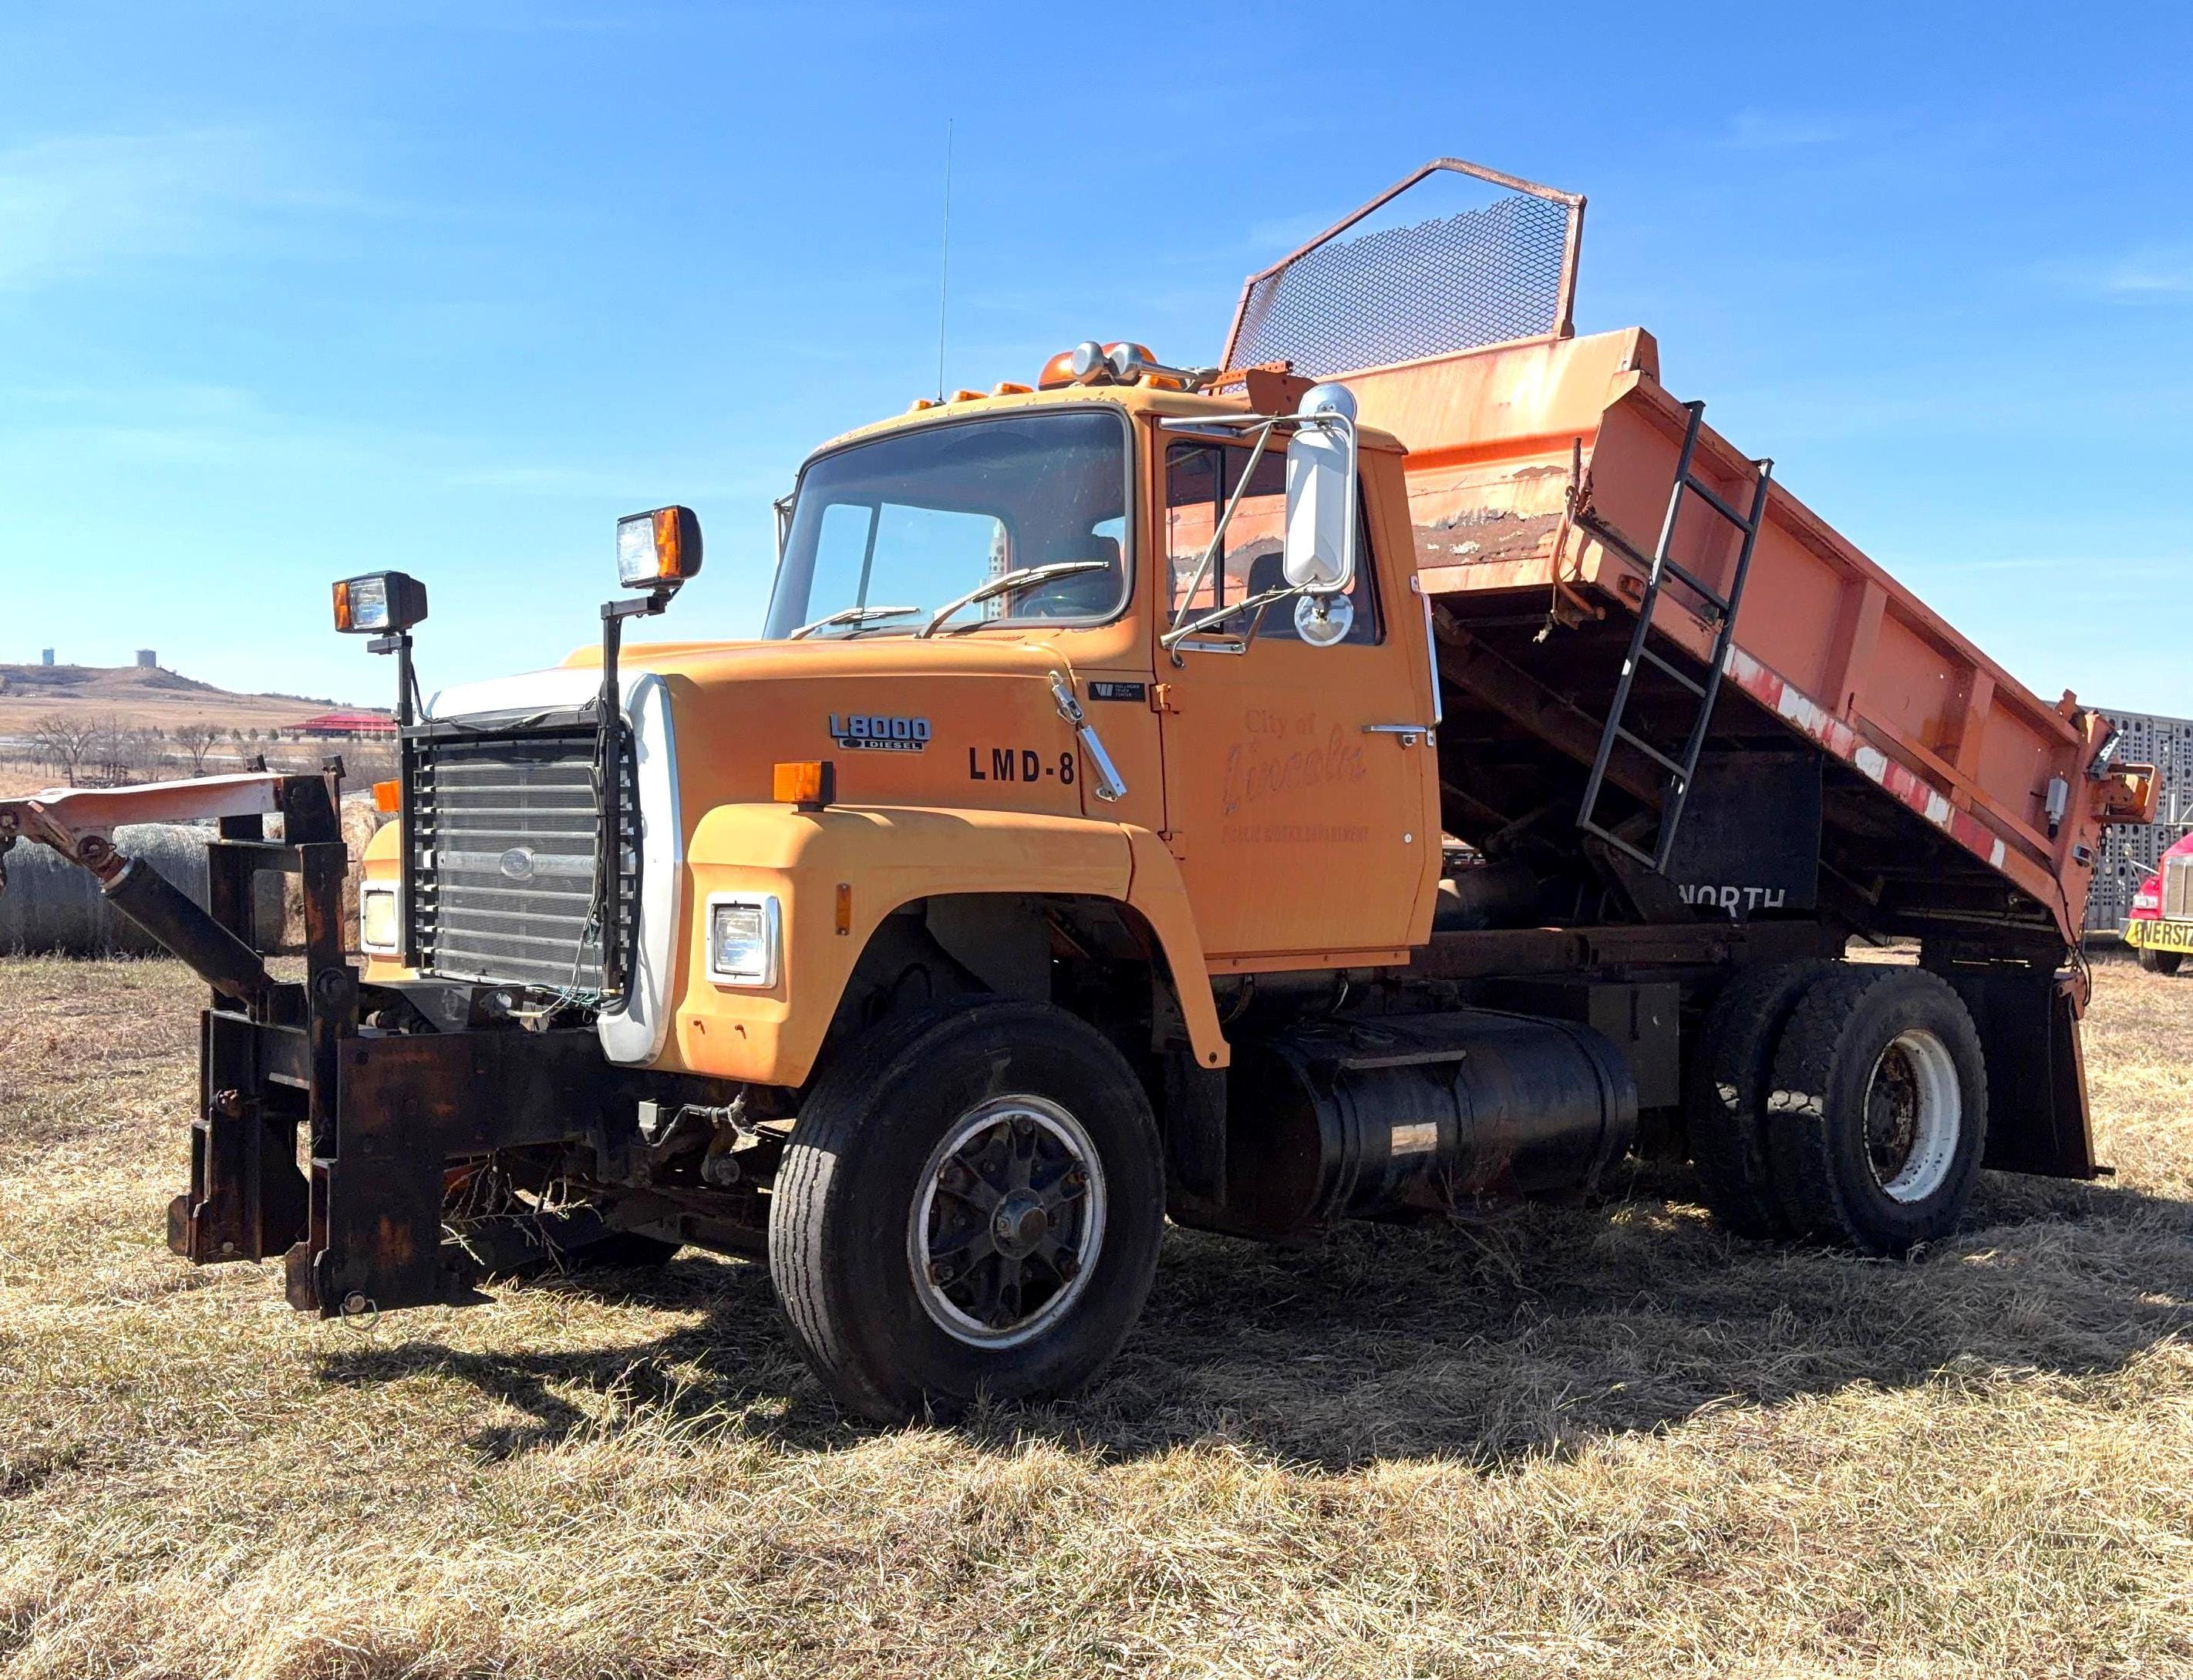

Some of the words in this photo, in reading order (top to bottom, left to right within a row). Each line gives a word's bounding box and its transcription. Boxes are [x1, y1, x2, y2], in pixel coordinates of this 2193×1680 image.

[829, 712, 932, 742] L8000
[869, 741, 920, 749] DIESEL
[969, 747, 1074, 785] LMD-8
